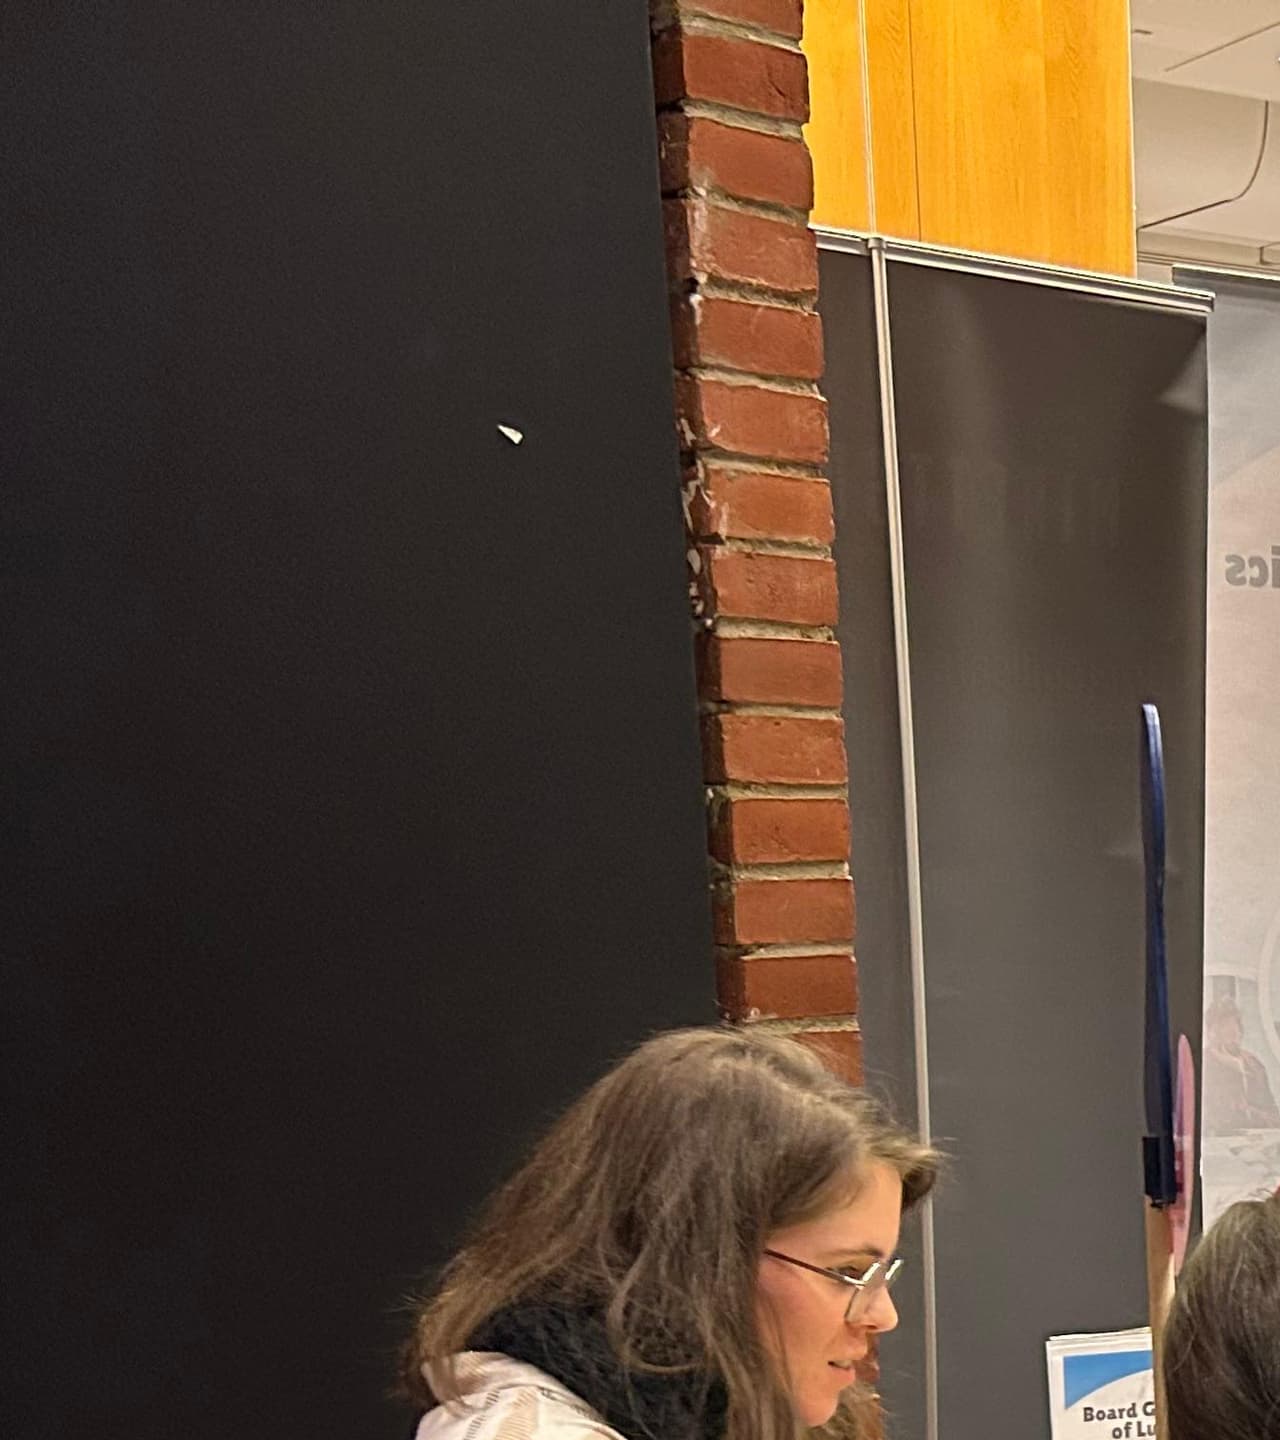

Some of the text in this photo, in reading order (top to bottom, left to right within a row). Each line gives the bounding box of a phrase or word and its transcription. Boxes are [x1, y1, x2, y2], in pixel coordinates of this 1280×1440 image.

[1083, 1402, 1137, 1422] Board
[1112, 1421, 1157, 1439] of Lu
